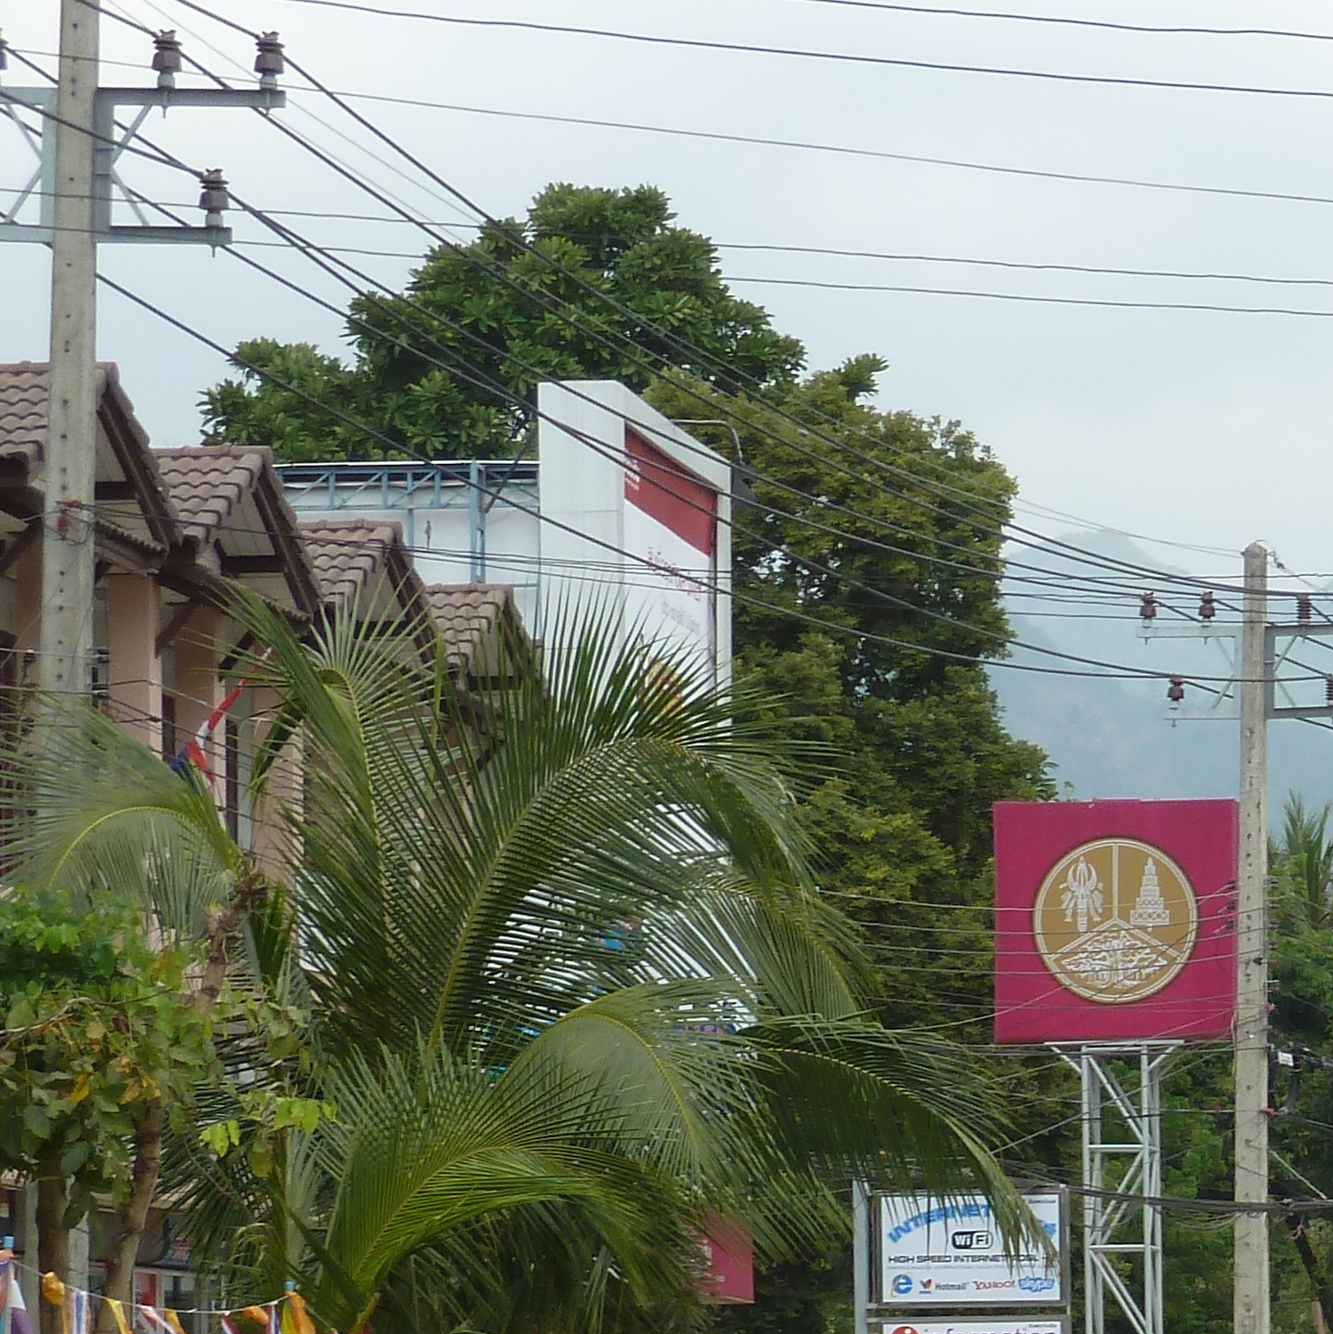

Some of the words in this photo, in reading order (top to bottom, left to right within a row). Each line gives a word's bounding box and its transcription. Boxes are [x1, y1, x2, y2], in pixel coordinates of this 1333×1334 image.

[889, 1255, 915, 1264] HIGH
[917, 1255, 952, 1263] SPEED
[954, 1254, 1005, 1263] INTERNET
